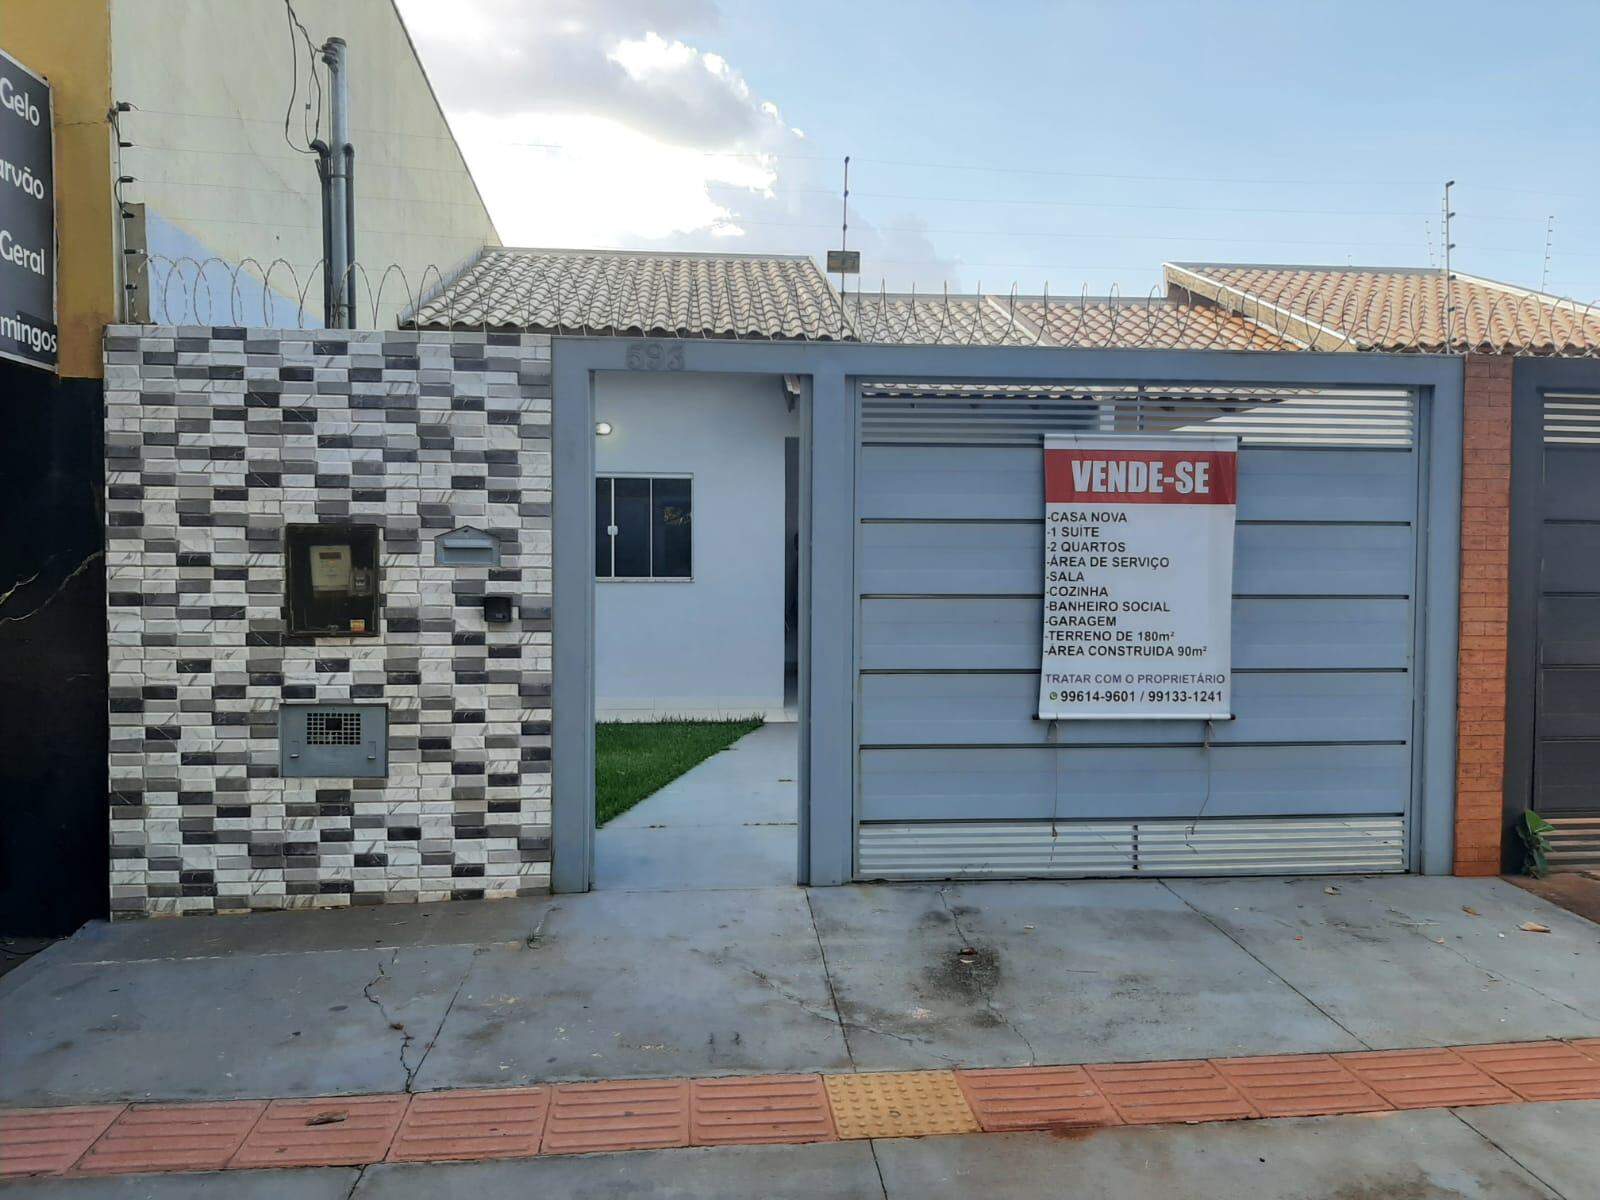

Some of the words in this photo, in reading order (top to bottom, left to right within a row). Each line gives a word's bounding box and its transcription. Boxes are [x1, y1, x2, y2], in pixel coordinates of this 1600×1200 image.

[0, 77, 40, 126] Gelo
[0, 230, 45, 275] Geral
[0, 314, 57, 353] mingos
[1071, 460, 1210, 494] VENDE-SE
[1047, 511, 1087, 523] -CASA
[1091, 511, 1128, 523] NOVA
[1047, 526, 1057, 537] -1
[1046, 541, 1057, 553] -2
[1061, 541, 1126, 553] QUARTOS
[1046, 554, 1086, 568] -ÁREA
[1090, 557, 1108, 568] DE
[1112, 556, 1170, 571] SERVIÇO
[1046, 571, 1085, 582] -SALA
[1046, 586, 1109, 597] -COZINHA
[1045, 601, 1119, 612] -BANHEIRO
[1122, 601, 1171, 612] SOCIAL
[1045, 616, 1117, 627] -GARAGEM
[1044, 630, 1112, 642] -TERRENO
[1116, 631, 1133, 642] DE
[1138, 631, 1175, 642] 180m²
[1177, 645, 1207, 657] 90m²
[1046, 674, 1091, 684] TRATAR
[1094, 674, 1122, 684] COM
[1125, 674, 1134, 684] O
[1137, 672, 1225, 685] PROPRIETÁRIO
[1060, 690, 1135, 703] 99614-9601
[1148, 690, 1222, 703] 99133-1241
